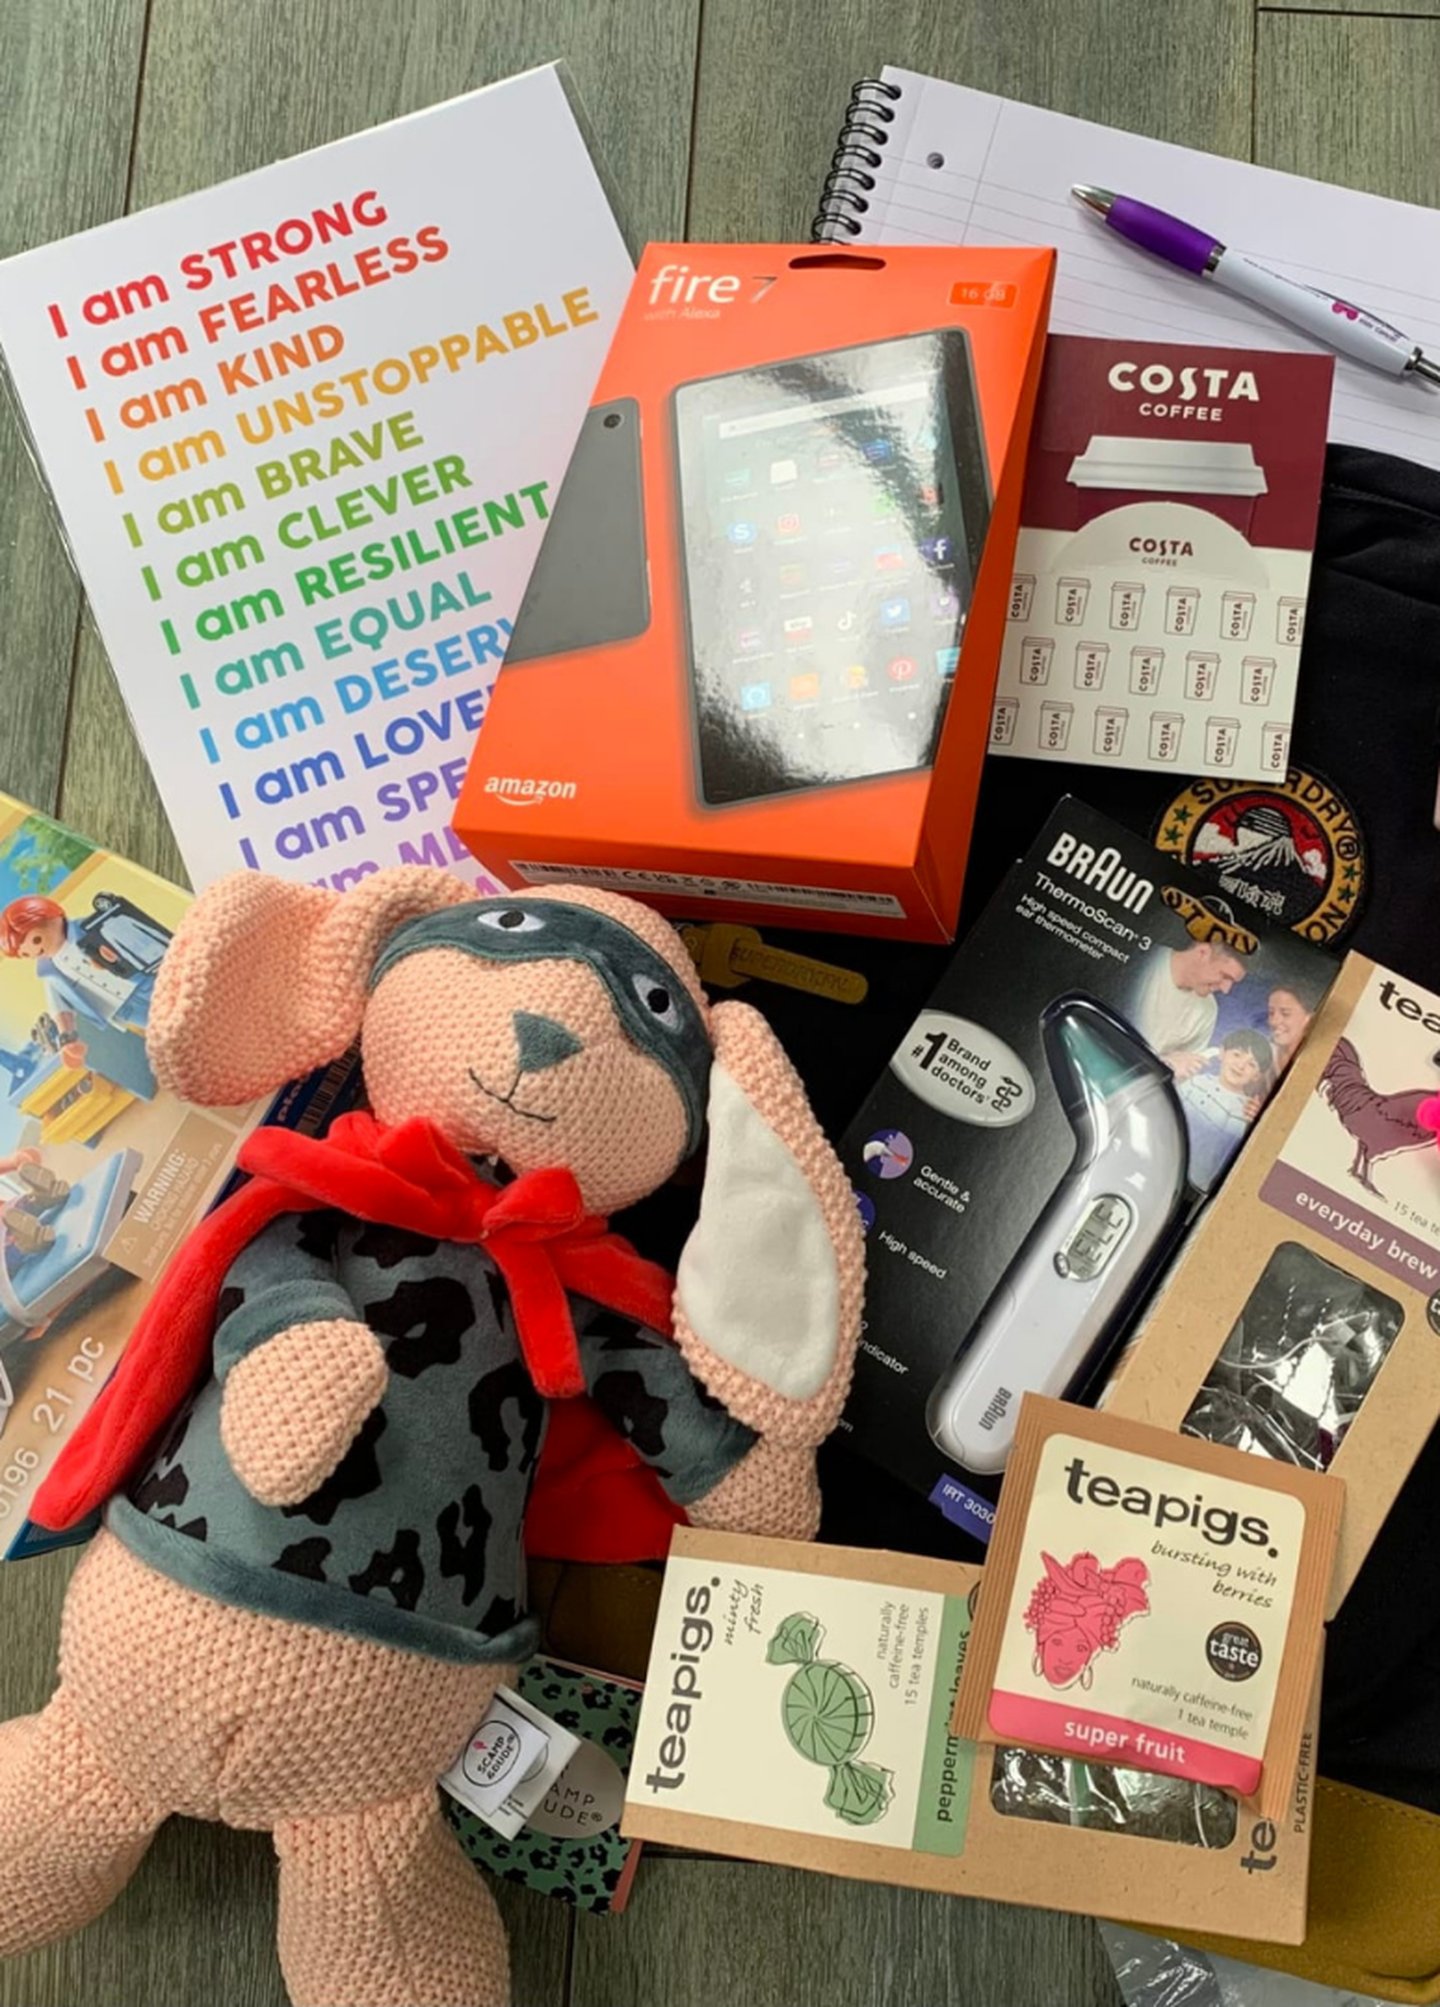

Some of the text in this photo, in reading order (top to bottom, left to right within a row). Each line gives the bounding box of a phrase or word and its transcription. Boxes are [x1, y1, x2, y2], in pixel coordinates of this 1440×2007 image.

[47, 191, 389, 339] I am STRONG
[649, 264, 778, 304] fire 7
[66, 226, 450, 390] I am FEARLESS
[84, 324, 345, 443] I am KIND
[103, 287, 600, 495] I am UNSTOPPABLE
[1108, 362, 1260, 401] COSTA
[1139, 402, 1223, 421] COFFEE
[122, 411, 425, 548] I am BRAVE
[141, 454, 473, 600] I am CLEVER
[1128, 537, 1194, 556] COSTA
[160, 481, 553, 655] I am RESILIENT
[1011, 584, 1023, 618] COSTA
[1065, 588, 1077, 622] COSTA
[1120, 592, 1132, 627] COSTA
[1174, 598, 1187, 632] COSTA
[1230, 602, 1243, 637] COSTA
[179, 571, 492, 709] I am EQUAL
[1286, 608, 1298, 642] COSTA
[1029, 648, 1041, 682] COSTA
[1084, 653, 1096, 687] COSTA
[1138, 657, 1151, 692] COSTA
[1194, 663, 1206, 698] COSTA
[1250, 668, 1263, 702] COSTA
[199, 727, 221, 764] I
[234, 696, 324, 750] am
[994, 707, 1006, 741] COSTA
[1048, 712, 1060, 747] COSTA
[1103, 718, 1115, 752] COSTA
[1158, 722, 1171, 758] COSTA
[219, 684, 495, 819] I am LOVE
[1214, 728, 1226, 763] COSTA
[1271, 733, 1283, 768] COSTA
[484, 776, 577, 799] amazon
[239, 838, 260, 870] I
[275, 805, 366, 860] am
[1046, 832, 1154, 915] BRAUN
[1015, 904, 1105, 960] ear thermometer
[1021, 894, 1130, 964] High speed compact
[1138, 935, 1152, 951] 3
[1379, 980, 1440, 1034] tea
[938, 1053, 987, 1090] among
[946, 1038, 992, 1072] Brand
[133, 1148, 188, 1225] WARNING:
[913, 1176, 965, 1213] accurate
[920, 1165, 971, 1203] Gentle &
[1394, 1201, 1409, 1216] 15
[1410, 1210, 1428, 1227] tea
[878, 1230, 947, 1279] High speed
[1296, 1190, 1438, 1280] everyday brew
[32, 1387, 74, 1433] 21
[67, 1337, 105, 1382] pc
[979, 1387, 1012, 1431] BRAUN
[942, 1484, 996, 1525] IRT 3030
[1064, 1458, 1278, 1558] teapigs.
[1151, 1540, 1277, 1587] bursting with
[724, 1579, 748, 1646] minty
[744, 1583, 765, 1635] fresh
[1212, 1580, 1274, 1608] berries
[877, 1601, 896, 1660] naturally
[888, 1603, 909, 1689] caffeine-free
[904, 1607, 929, 1705] 15 tea temples
[1210, 1639, 1258, 1668] taste
[645, 1576, 721, 1794] teapigs.
[1131, 1676, 1253, 1721] naturally caffeine-free
[1064, 1720, 1186, 1764] super fruit
[1188, 1712, 1206, 1728] tea
[1209, 1719, 1249, 1740] temple
[477, 1736, 505, 1774] SCAMP
[1293, 1732, 1312, 1834] PLASTIC-FREE
